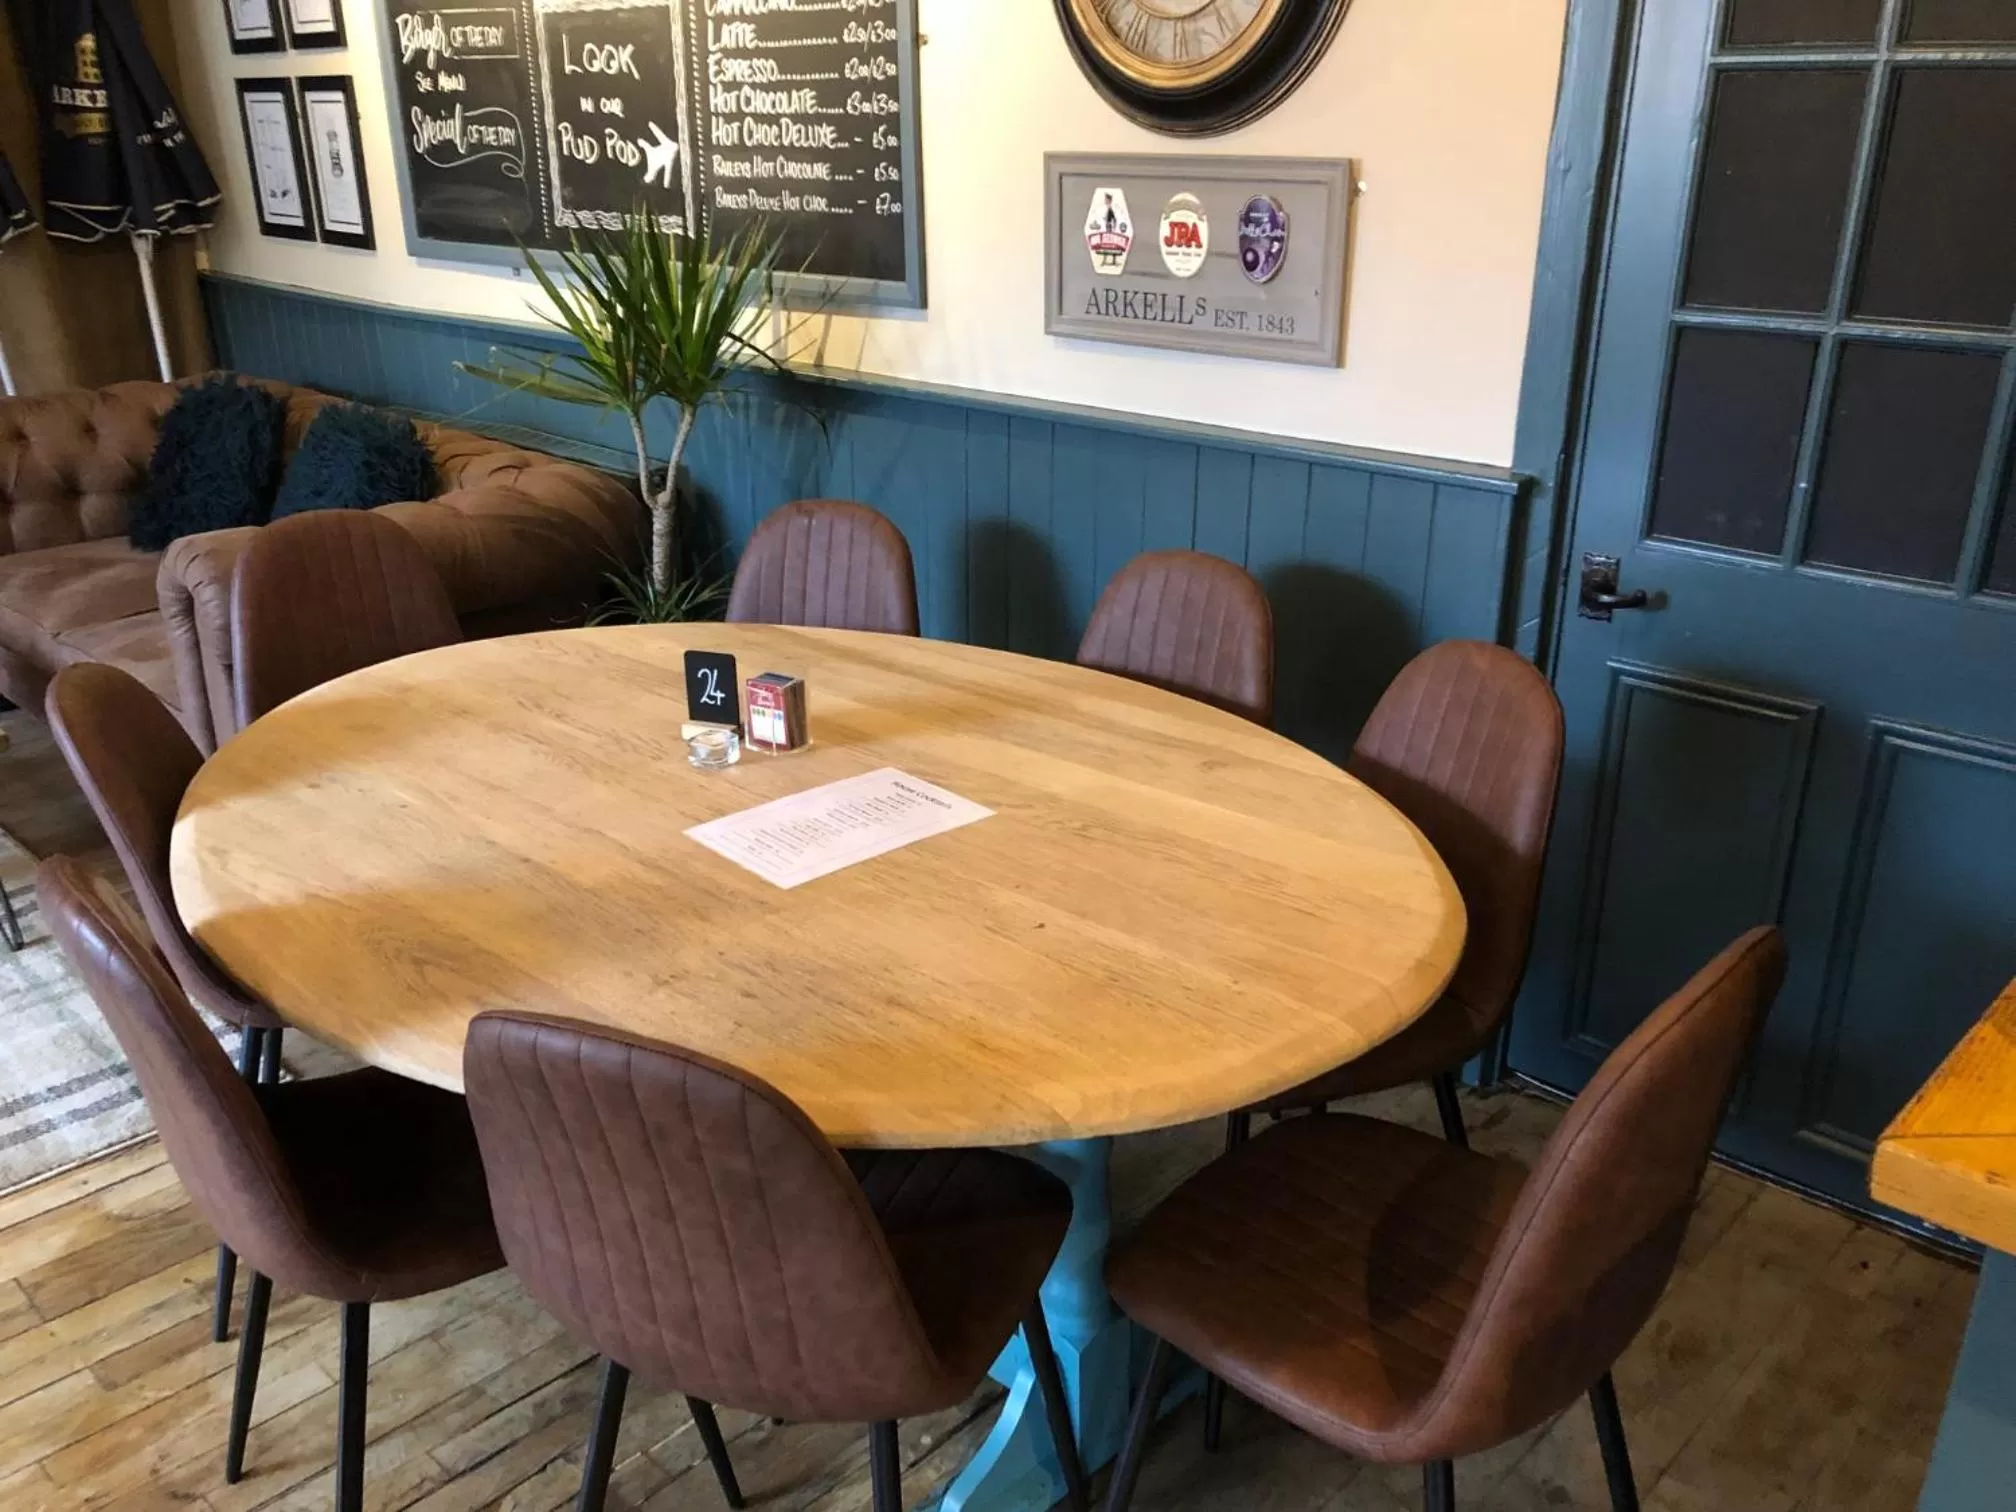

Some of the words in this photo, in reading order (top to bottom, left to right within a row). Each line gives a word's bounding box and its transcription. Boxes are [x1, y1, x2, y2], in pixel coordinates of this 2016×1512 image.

[707, 19, 758, 51] LATTE
[562, 34, 640, 80] LOOK
[707, 52, 779, 83] ESPRESSO
[600, 97, 625, 118] OUR
[709, 83, 739, 114] HOT
[740, 85, 818, 115] CHOCOLATE
[558, 122, 599, 164] PUD
[604, 127, 642, 167] POD
[711, 116, 741, 146] HOT
[743, 116, 780, 147] CHOC
[780, 117, 838, 149] DELUXE
[753, 154, 777, 178] HOT
[776, 155, 832, 181] CHOCOLATE
[782, 189, 801, 211] HOT
[1214, 309, 1250, 332] EST.
[1257, 314, 1295, 335] 1843
[697, 668, 726, 706] 24
